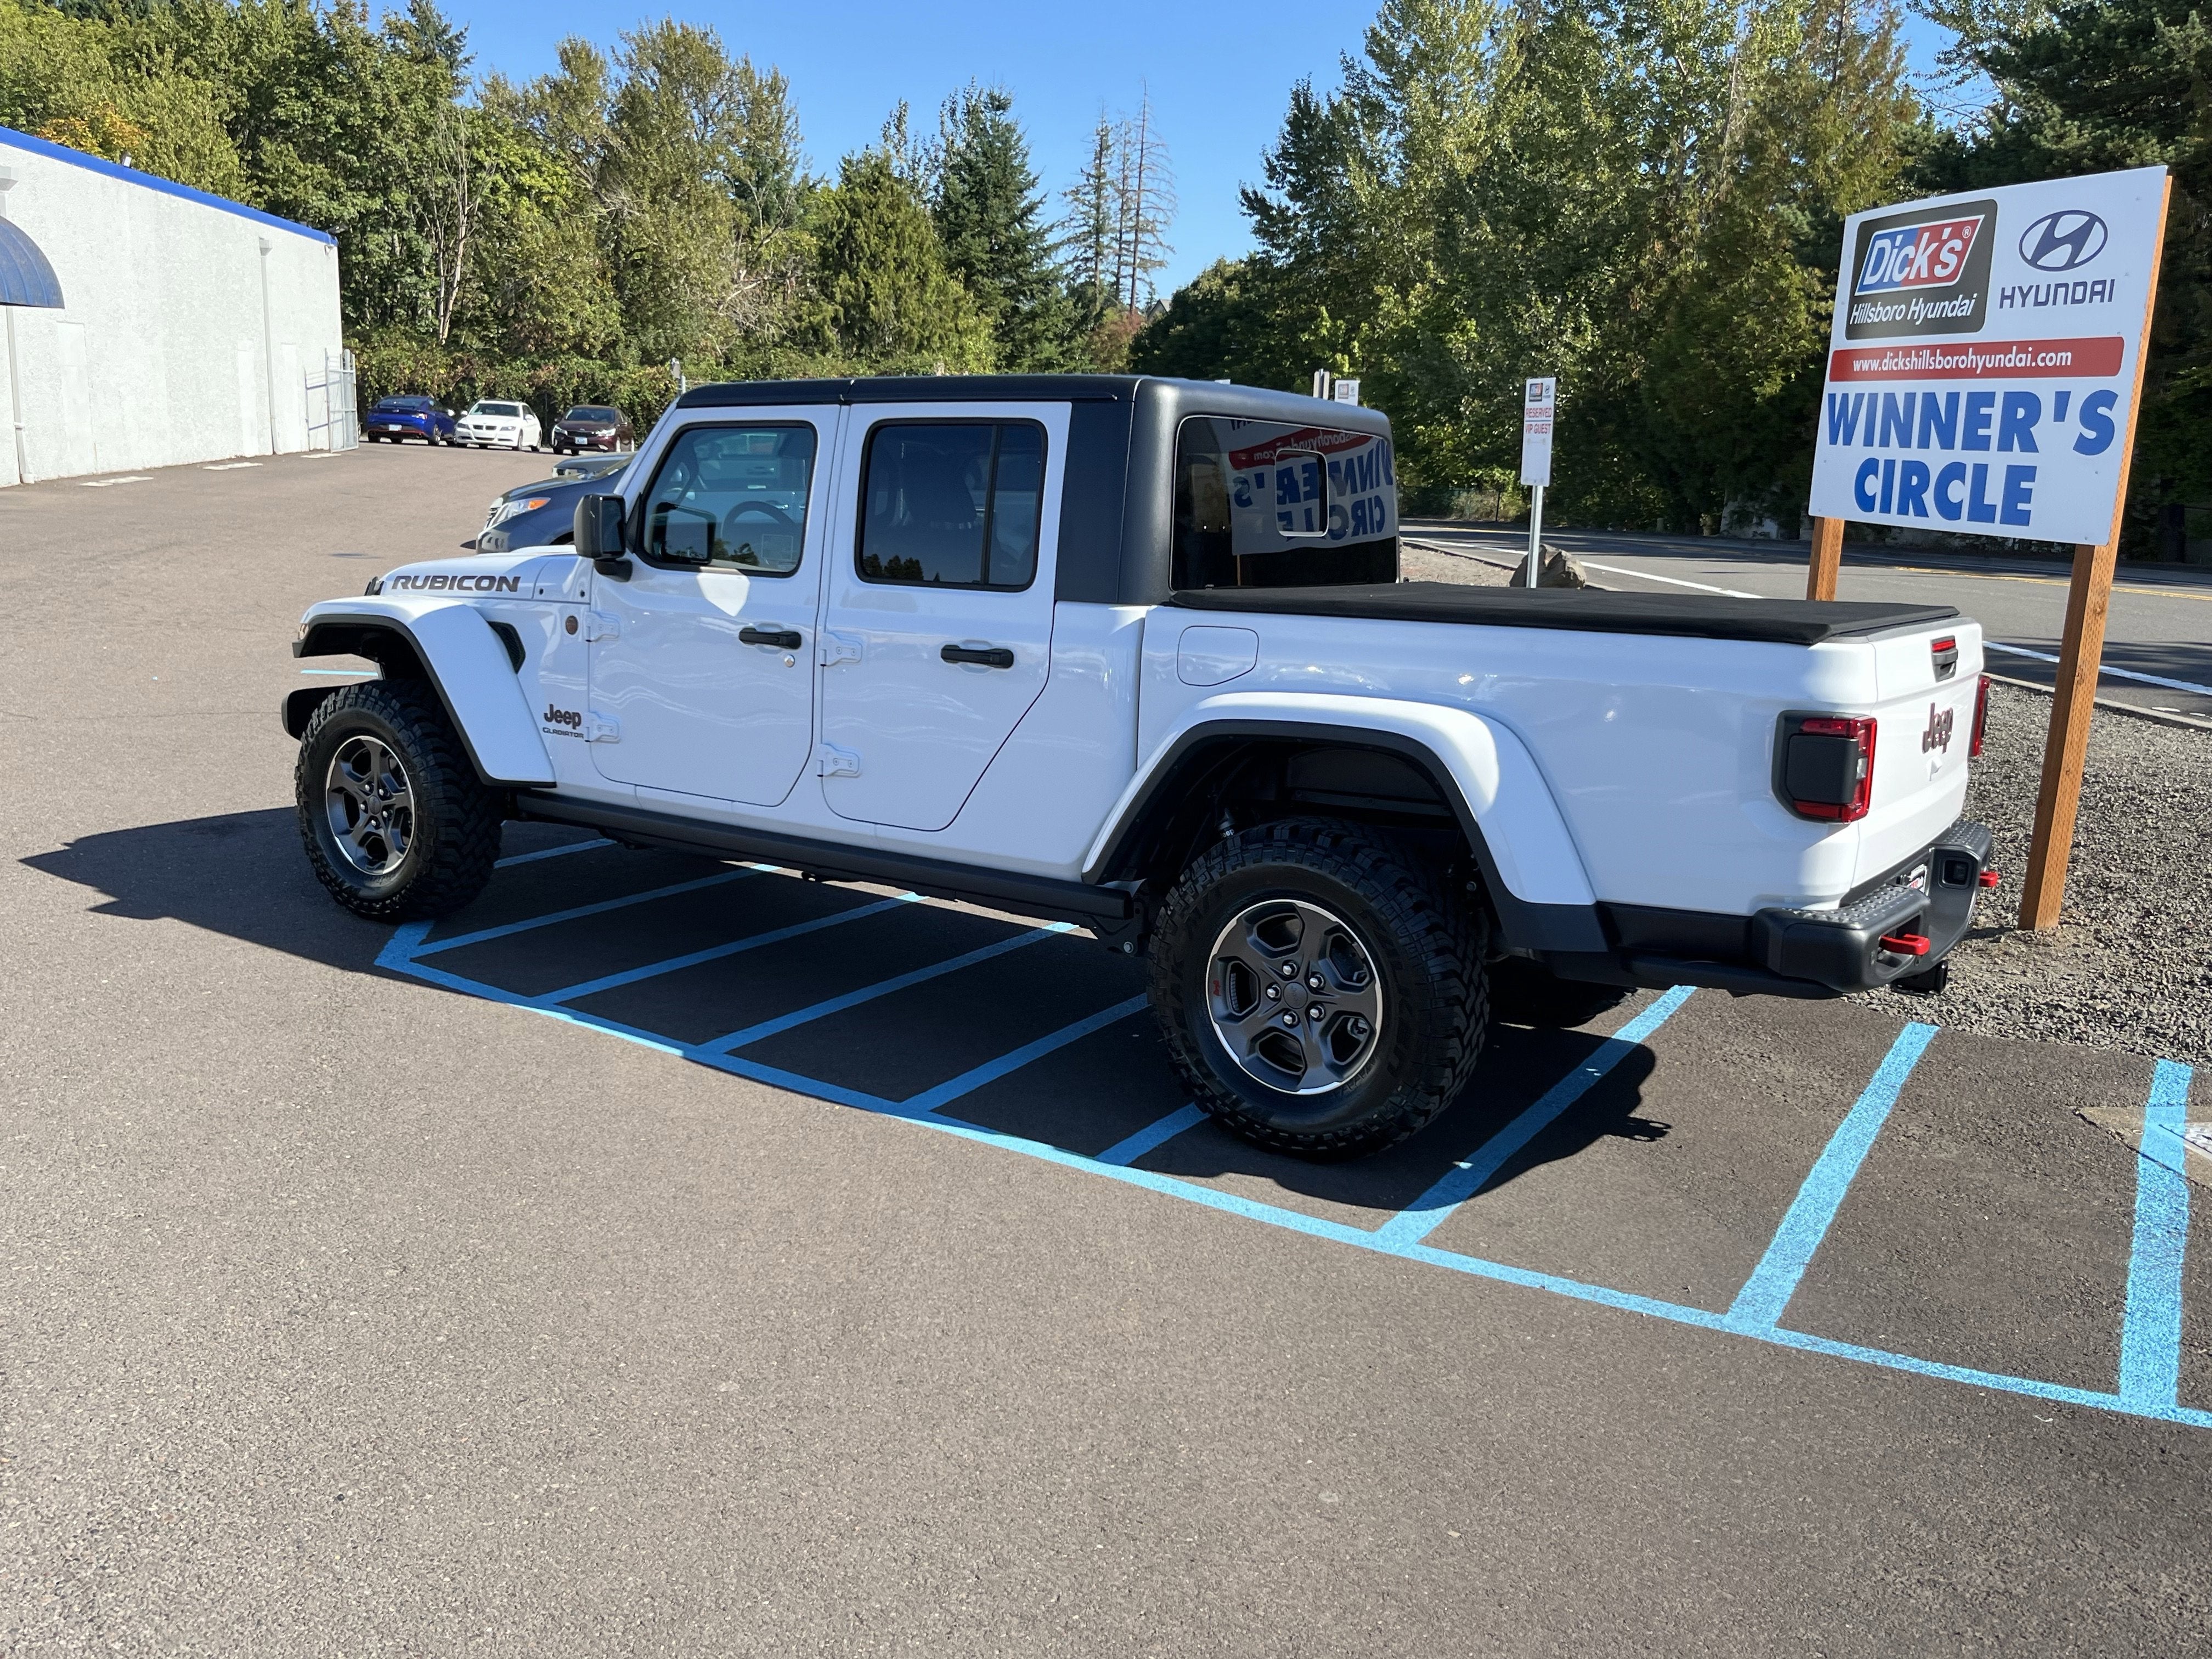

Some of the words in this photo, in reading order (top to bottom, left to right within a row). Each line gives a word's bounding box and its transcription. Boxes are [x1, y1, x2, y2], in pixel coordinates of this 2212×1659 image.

[1863, 227, 1963, 285] Dick's
[1999, 279, 2115, 309] HYUNDAI
[1849, 302, 1906, 325] Hillsboro
[1907, 293, 1978, 325] Hyundai
[1853, 346, 2072, 374] www.dickshillsborohyundai.com
[1526, 407, 1551, 417] RESERVED
[1827, 390, 2119, 456] WINNER'S
[1534, 424, 1551, 434] GUEST
[1854, 457, 2038, 527] CIRCLE
[392, 575, 521, 592] RUBICON
[544, 703, 582, 730] Jeep
[1922, 702, 1954, 754] Jeep
[543, 727, 584, 739] GLADIATOR
